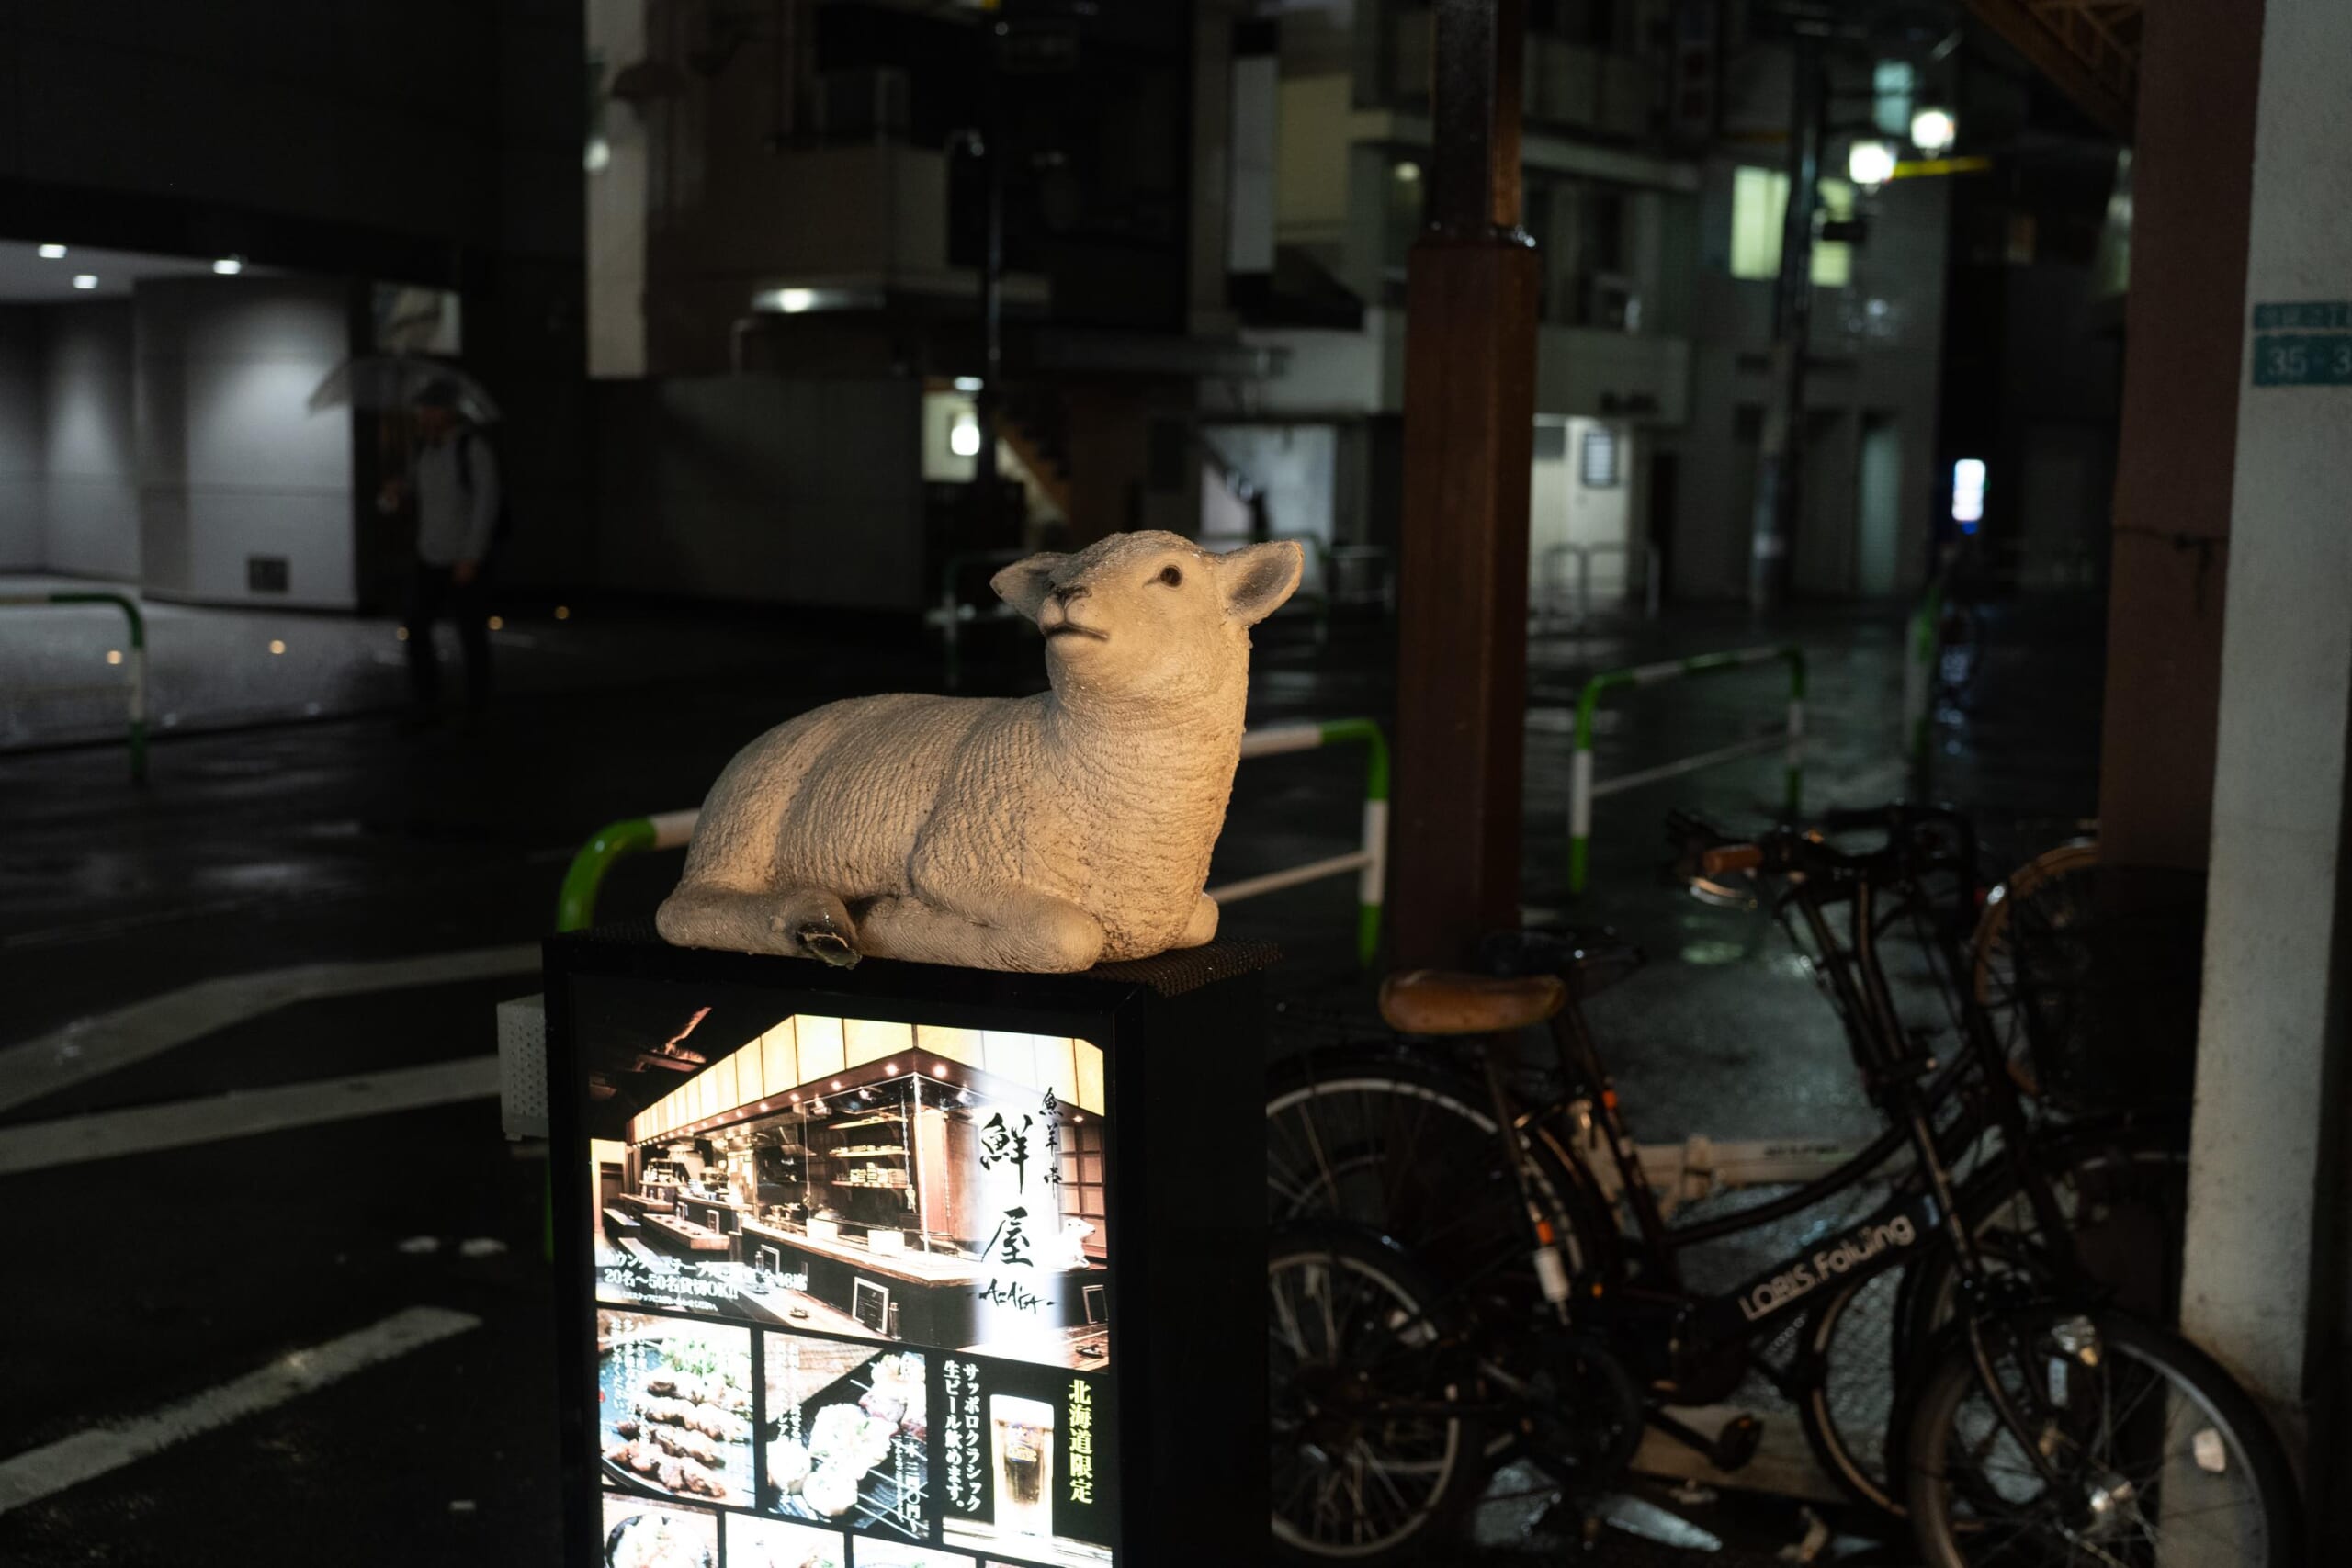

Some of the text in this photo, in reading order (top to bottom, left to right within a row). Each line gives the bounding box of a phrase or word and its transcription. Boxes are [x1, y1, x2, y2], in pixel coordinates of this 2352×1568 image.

[943, 1360, 964, 1507] 生ビール飲めます。
[963, 1363, 982, 1512] サッポロクラシック
[1069, 1379, 1093, 1505] 北海道限定
